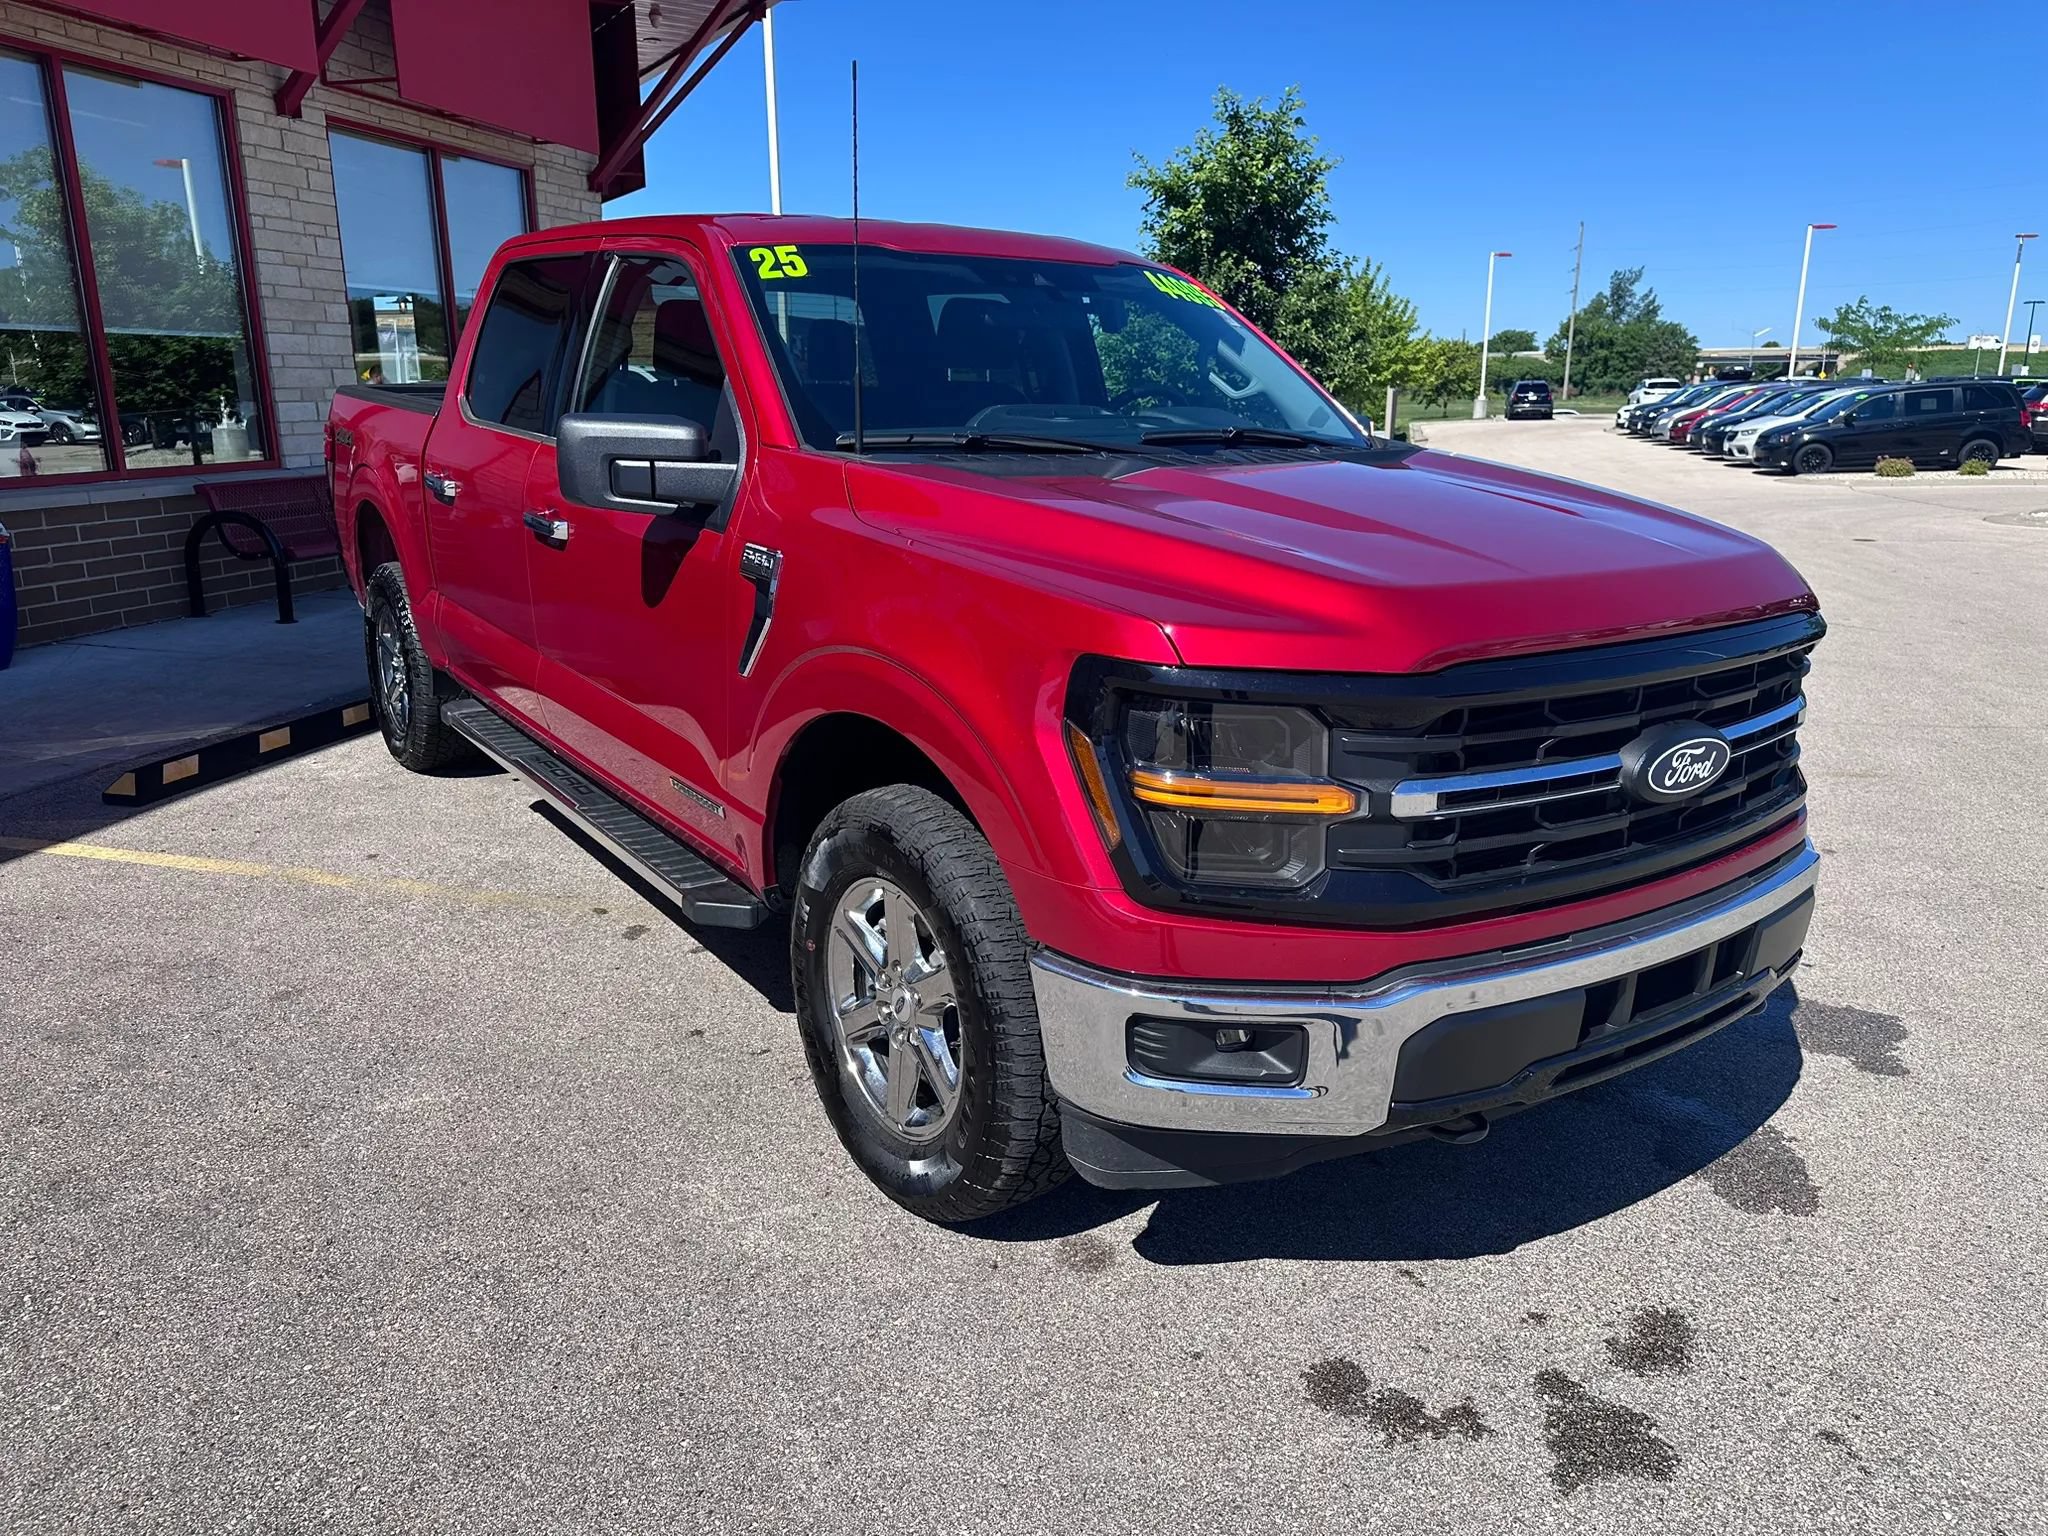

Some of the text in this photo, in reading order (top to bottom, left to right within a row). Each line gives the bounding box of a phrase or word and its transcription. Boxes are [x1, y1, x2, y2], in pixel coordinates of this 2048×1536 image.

[749, 245, 808, 279] 25
[1143, 270, 1226, 310] 44995
[1665, 746, 1717, 787] Ford
